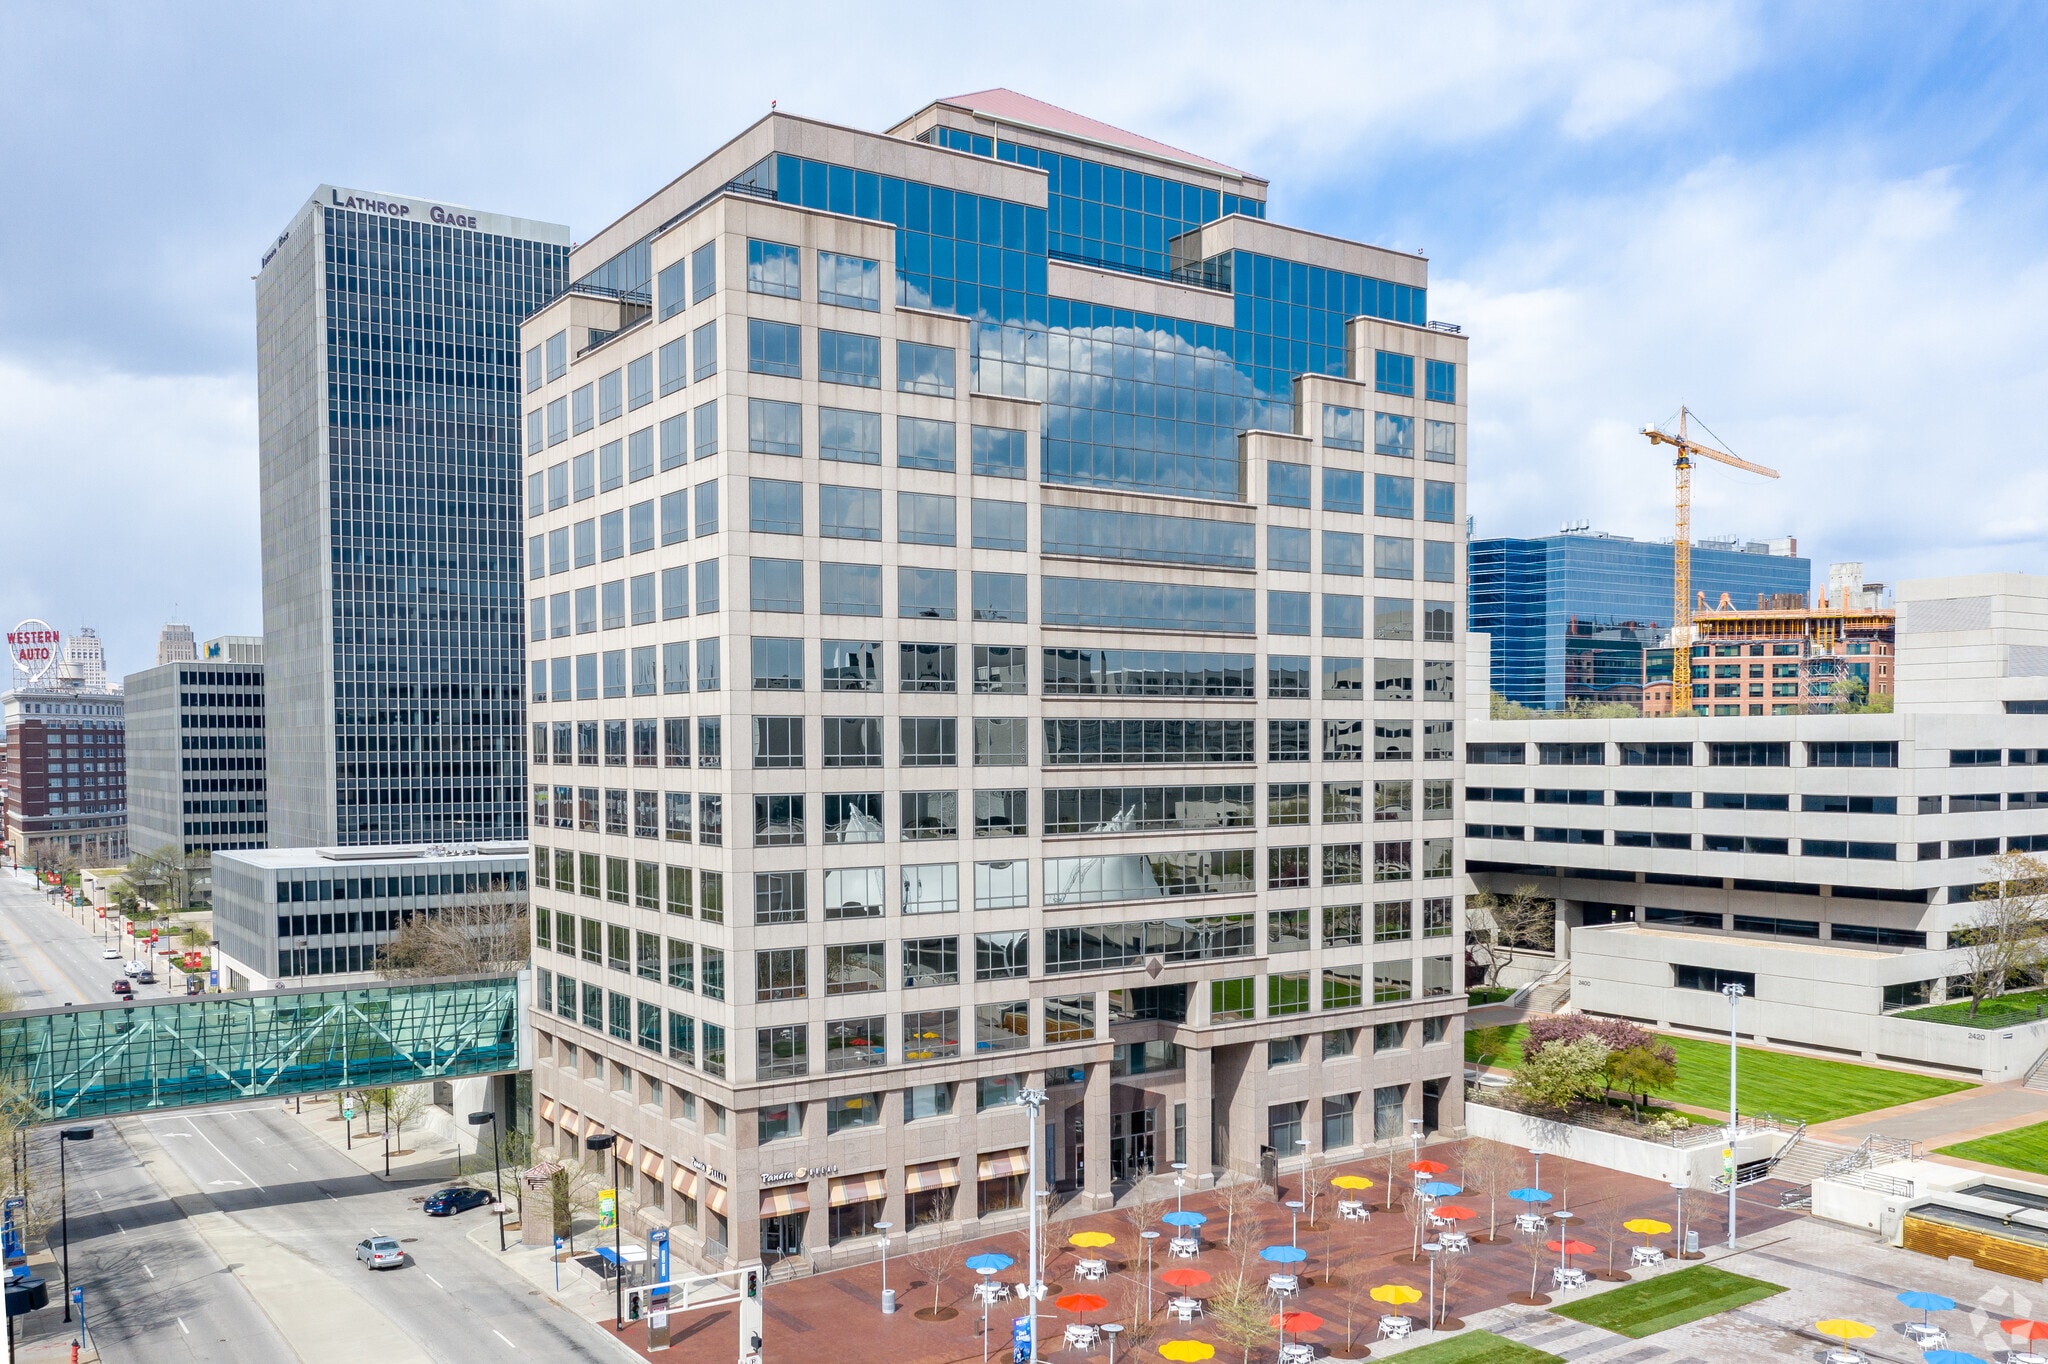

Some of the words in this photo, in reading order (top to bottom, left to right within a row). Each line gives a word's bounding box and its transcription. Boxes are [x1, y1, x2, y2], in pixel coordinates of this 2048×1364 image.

[332, 189, 410, 217] LATHROP
[430, 206, 477, 229] GAGE
[6, 630, 60, 645] WESTERN
[19, 647, 50, 661] AUTO
[1967, 1032, 1986, 1041] 2420
[760, 1171, 795, 1184] Panera
